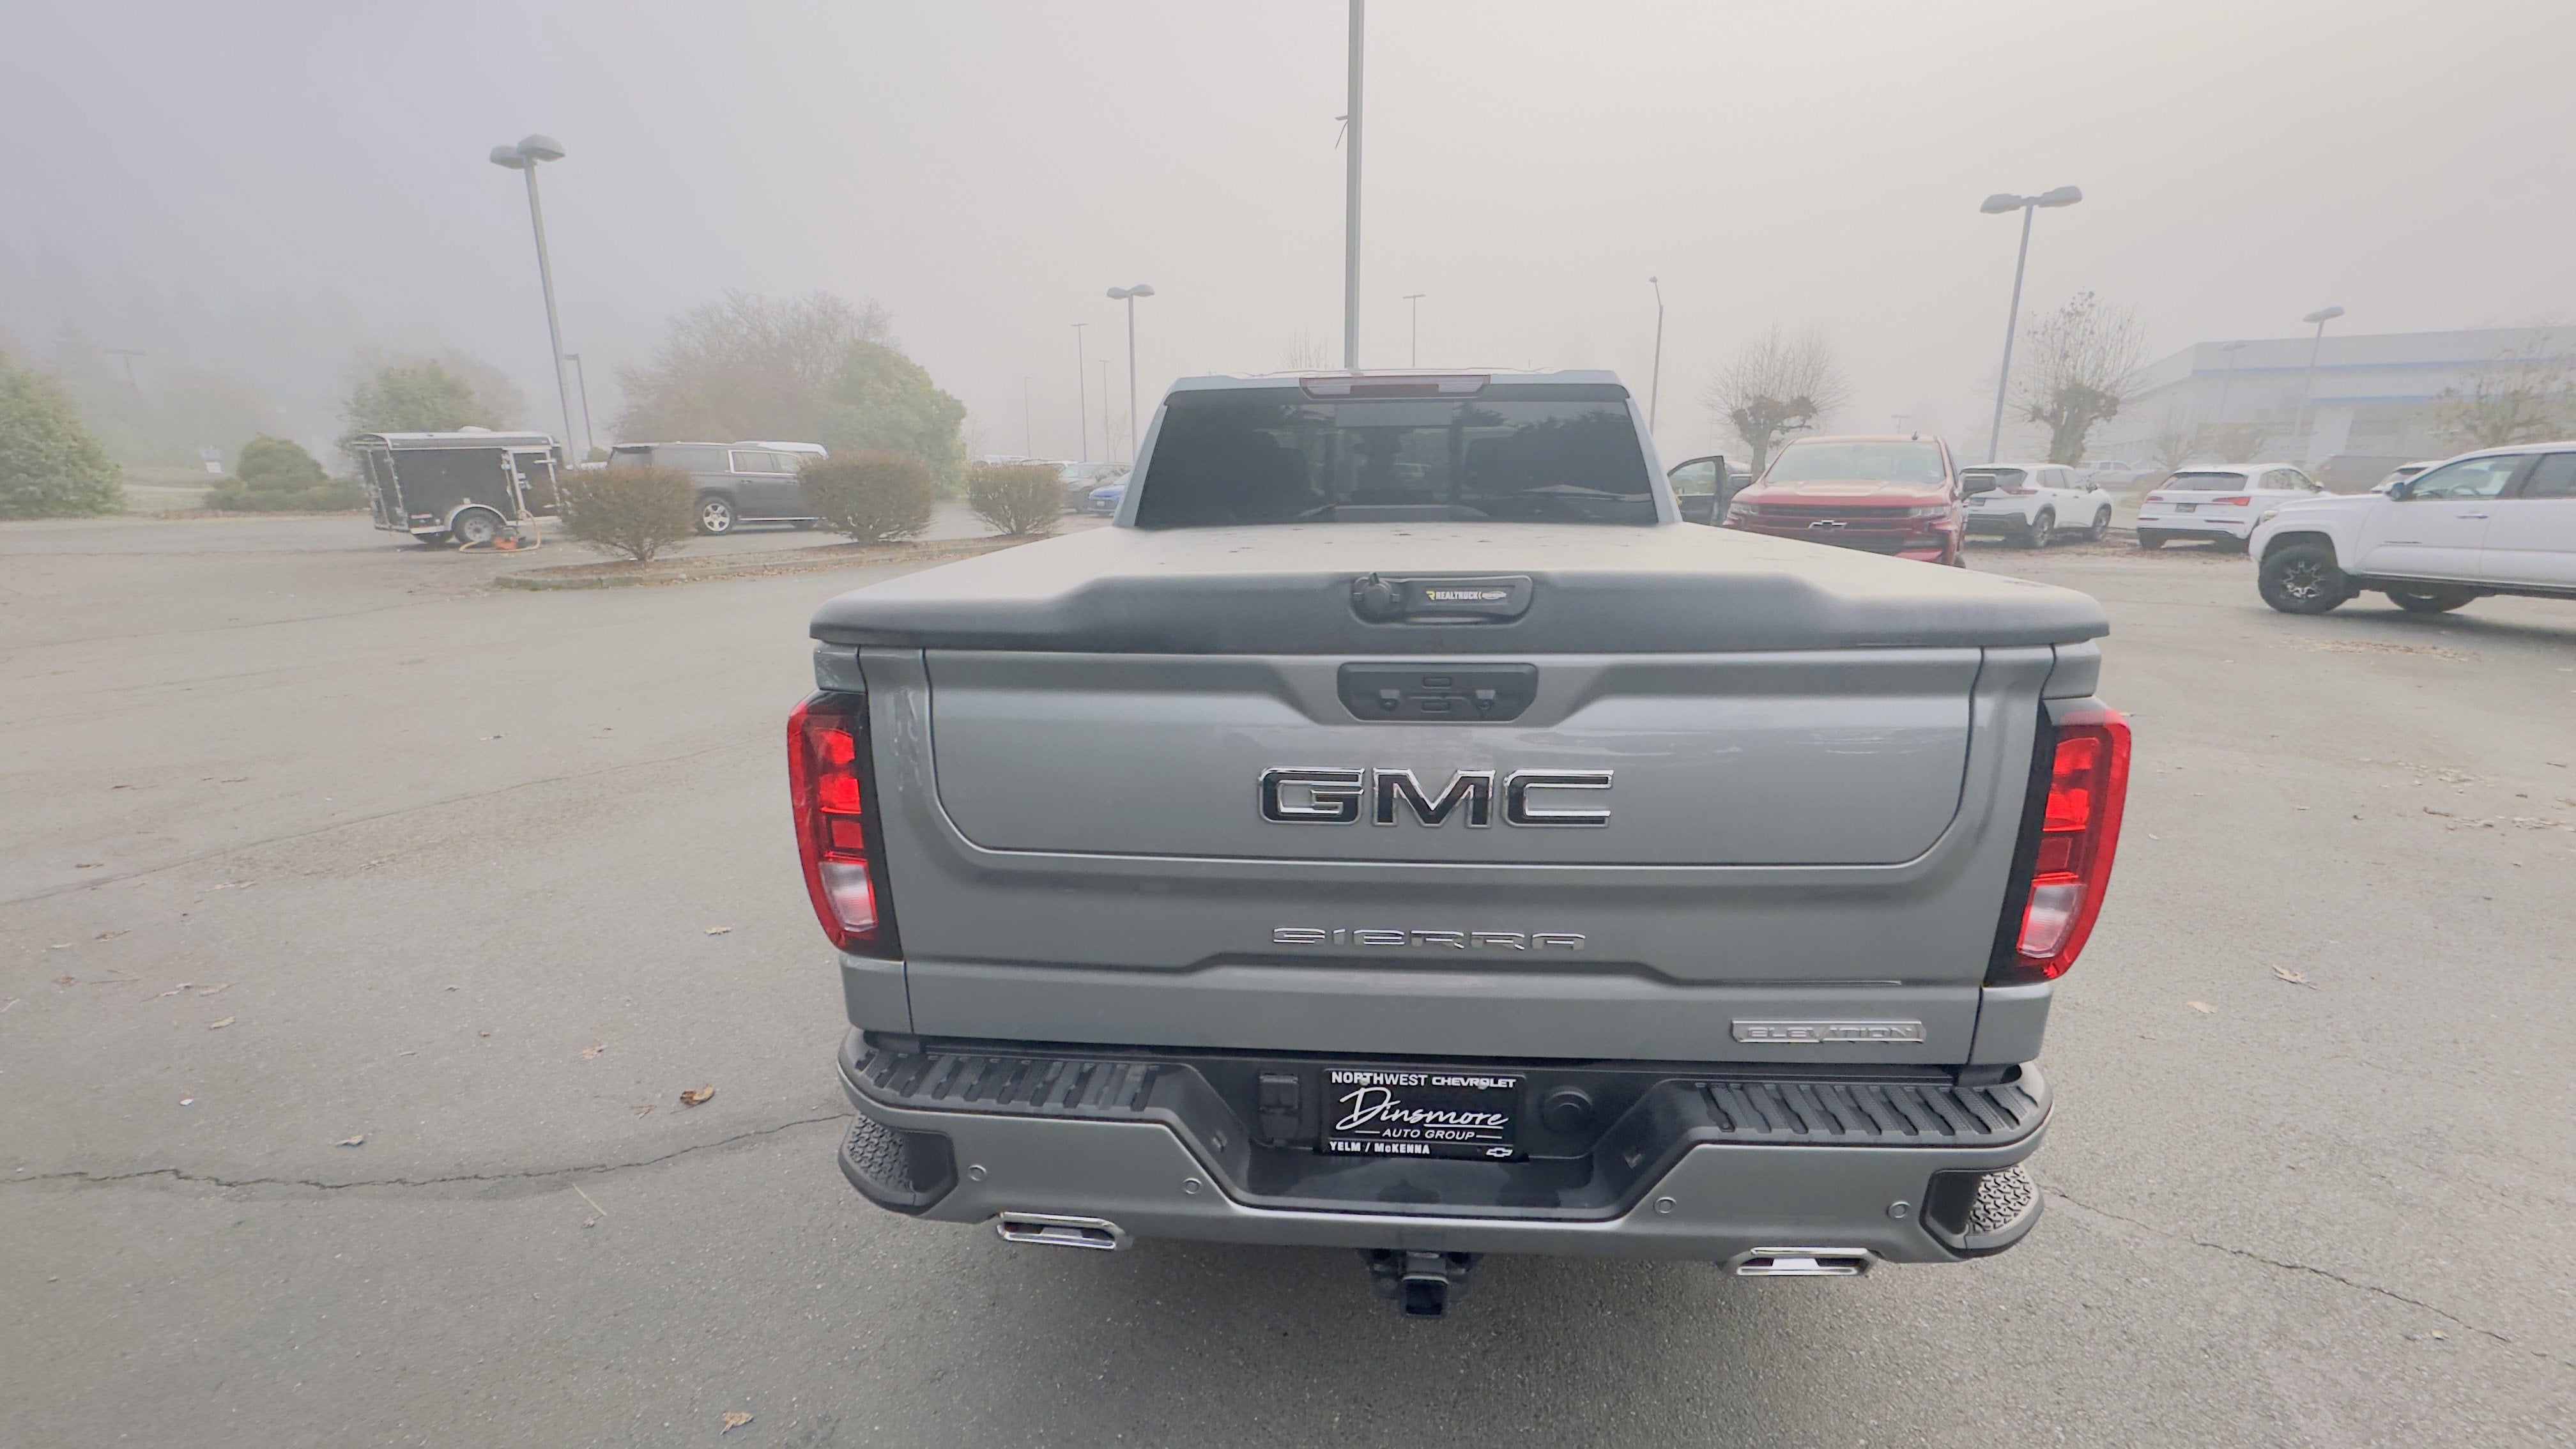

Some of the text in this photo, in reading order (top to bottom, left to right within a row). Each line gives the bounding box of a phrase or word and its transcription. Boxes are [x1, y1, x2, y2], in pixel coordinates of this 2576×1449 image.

[1436, 591, 1478, 600] REALTRUCK
[1258, 767, 1613, 827] GMC
[1273, 928, 1585, 949] SIERRA
[1747, 1026, 1919, 1039] ELEVATION
[1331, 1071, 1516, 1088] NORTHWEST CHEVROLET
[1335, 1086, 1509, 1131] Dinsmore
[1382, 1129, 1475, 1140] AUTO GROUP
[1330, 1141, 1430, 1154] YELM / McKENNA
